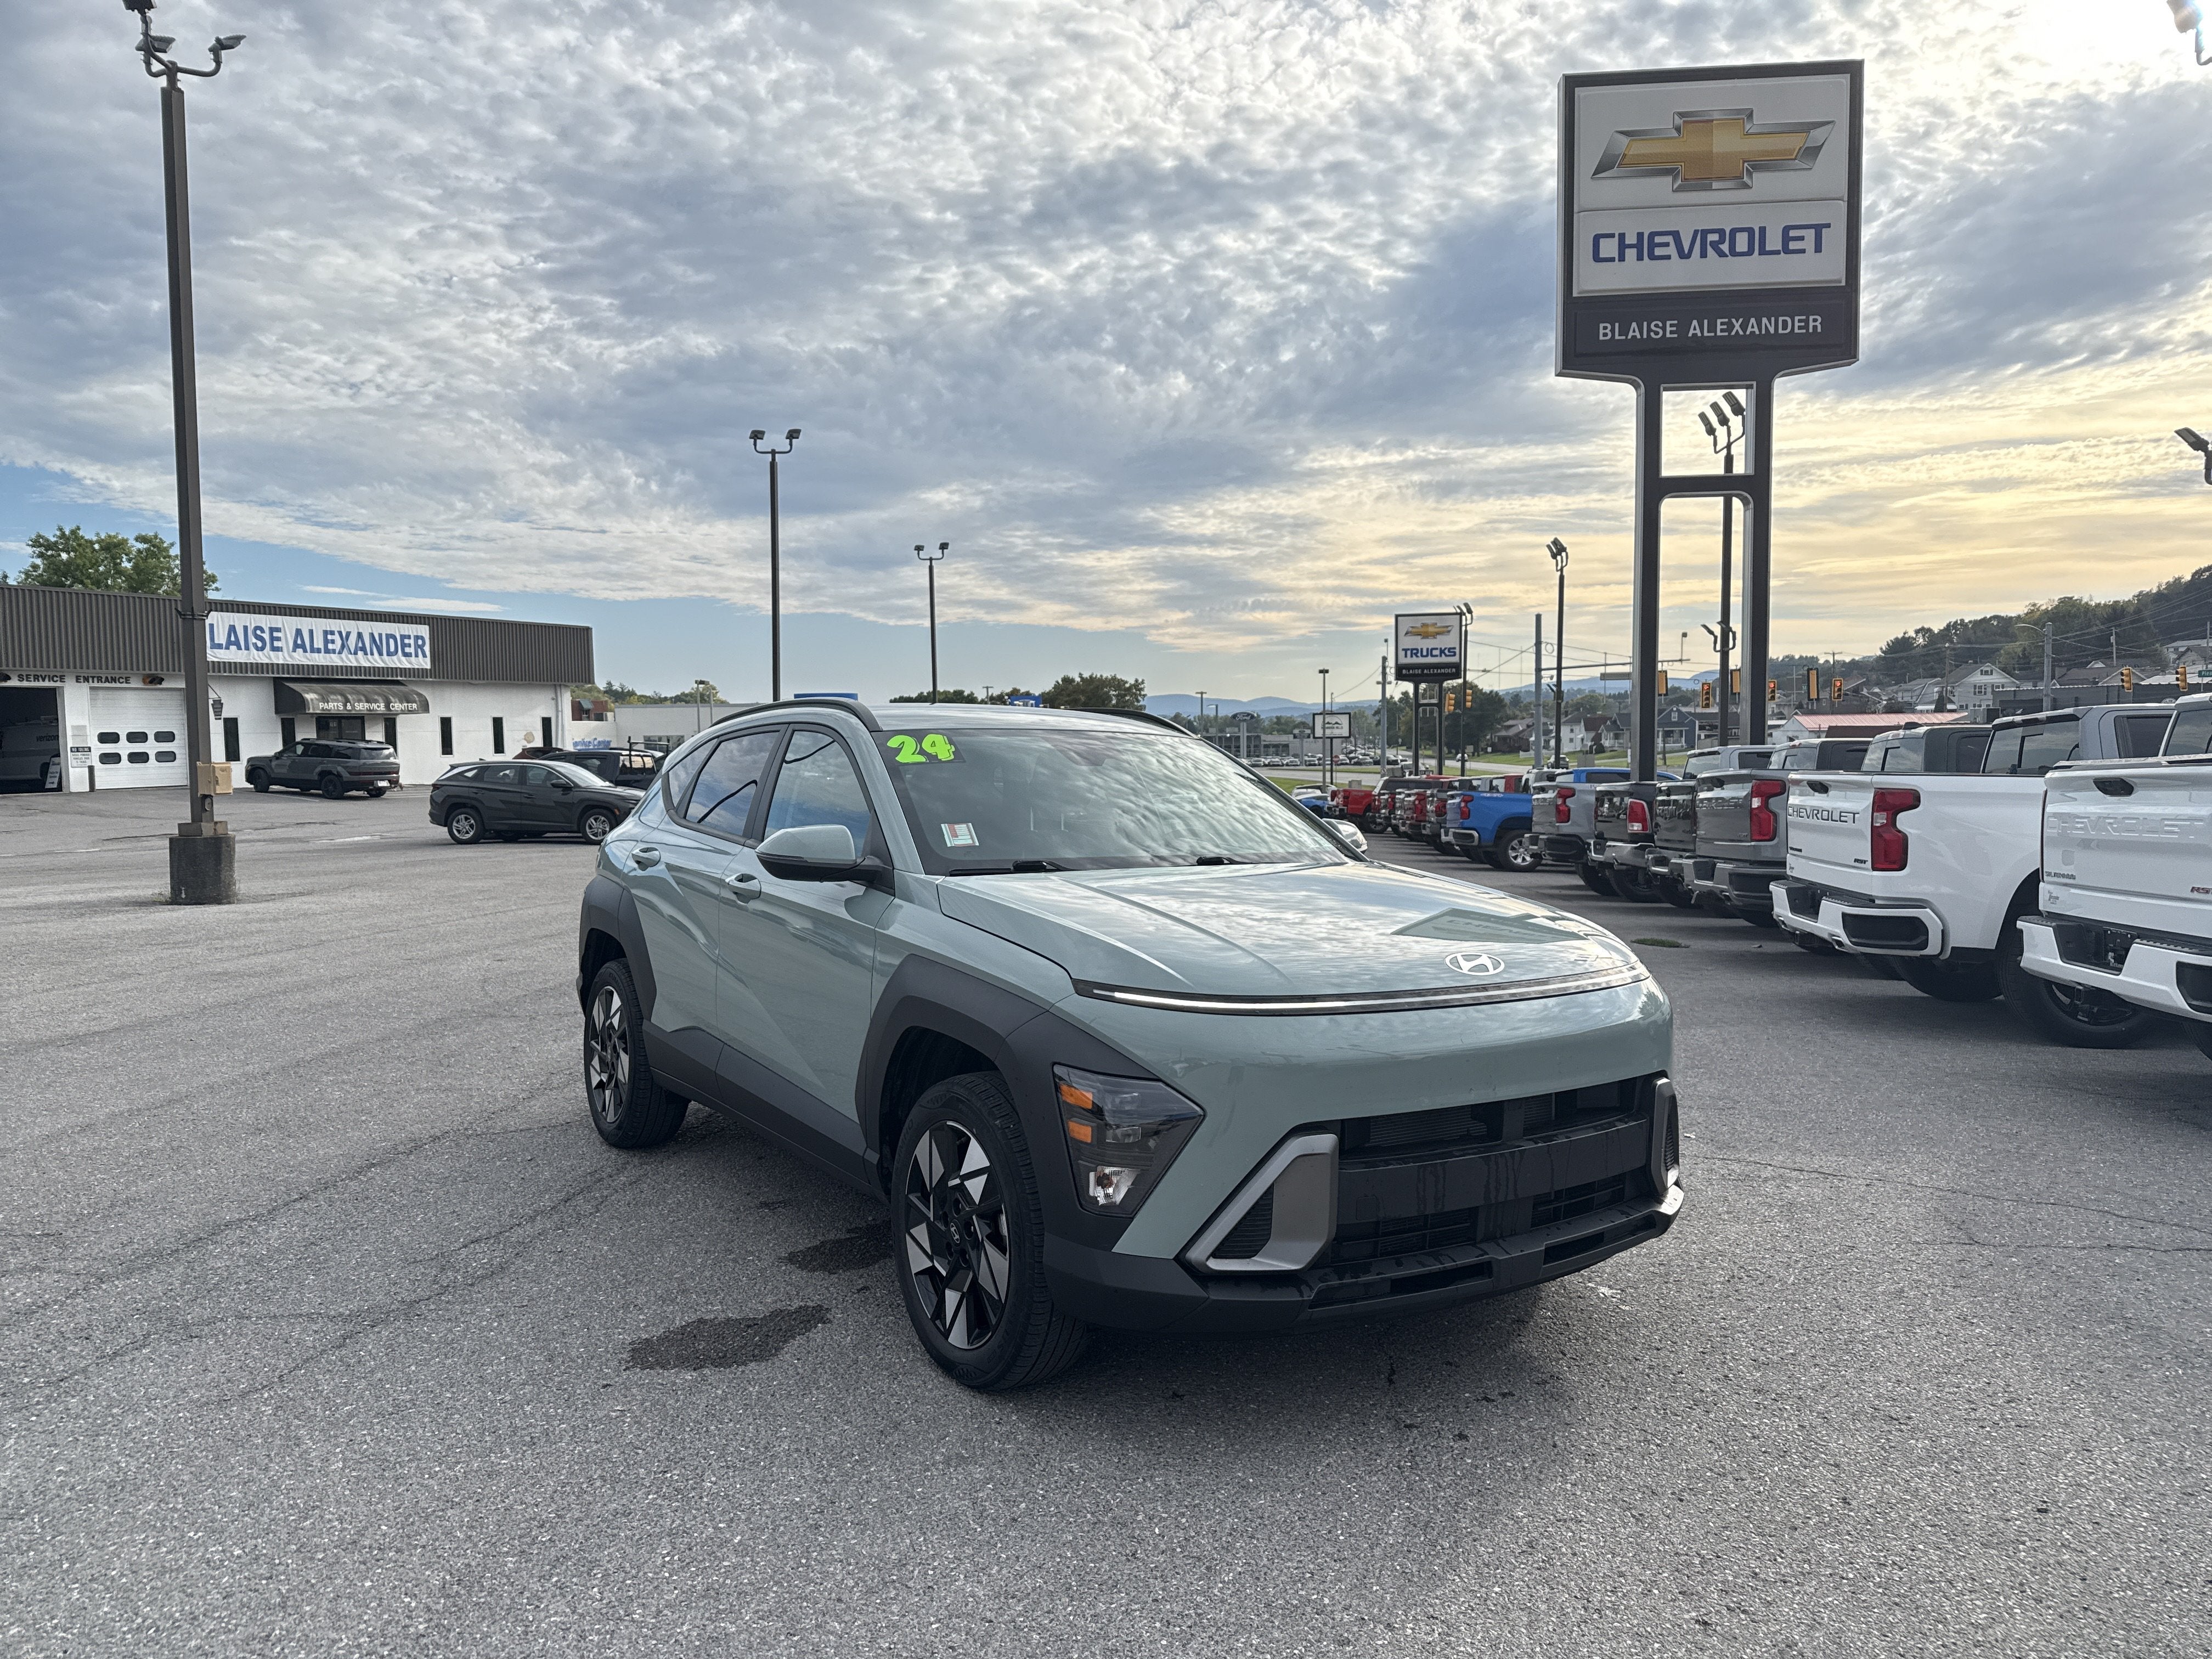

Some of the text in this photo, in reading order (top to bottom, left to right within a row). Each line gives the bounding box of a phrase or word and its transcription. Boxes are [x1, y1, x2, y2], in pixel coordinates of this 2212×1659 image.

[1592, 223, 1831, 263] CHEVROLET
[1599, 315, 1822, 341] BLAISE ALEXANDER
[208, 623, 428, 658] LAISE ALEXANDER
[1402, 647, 1457, 658] TRUCKS
[17, 674, 131, 684] SERVICE ENTRANCE
[319, 702, 343, 710] PARTS
[36, 733, 59, 742] verizon
[887, 733, 956, 763] 24
[1787, 806, 1860, 824] CHEVROLET
[2047, 816, 2204, 838] CHEVROLET
